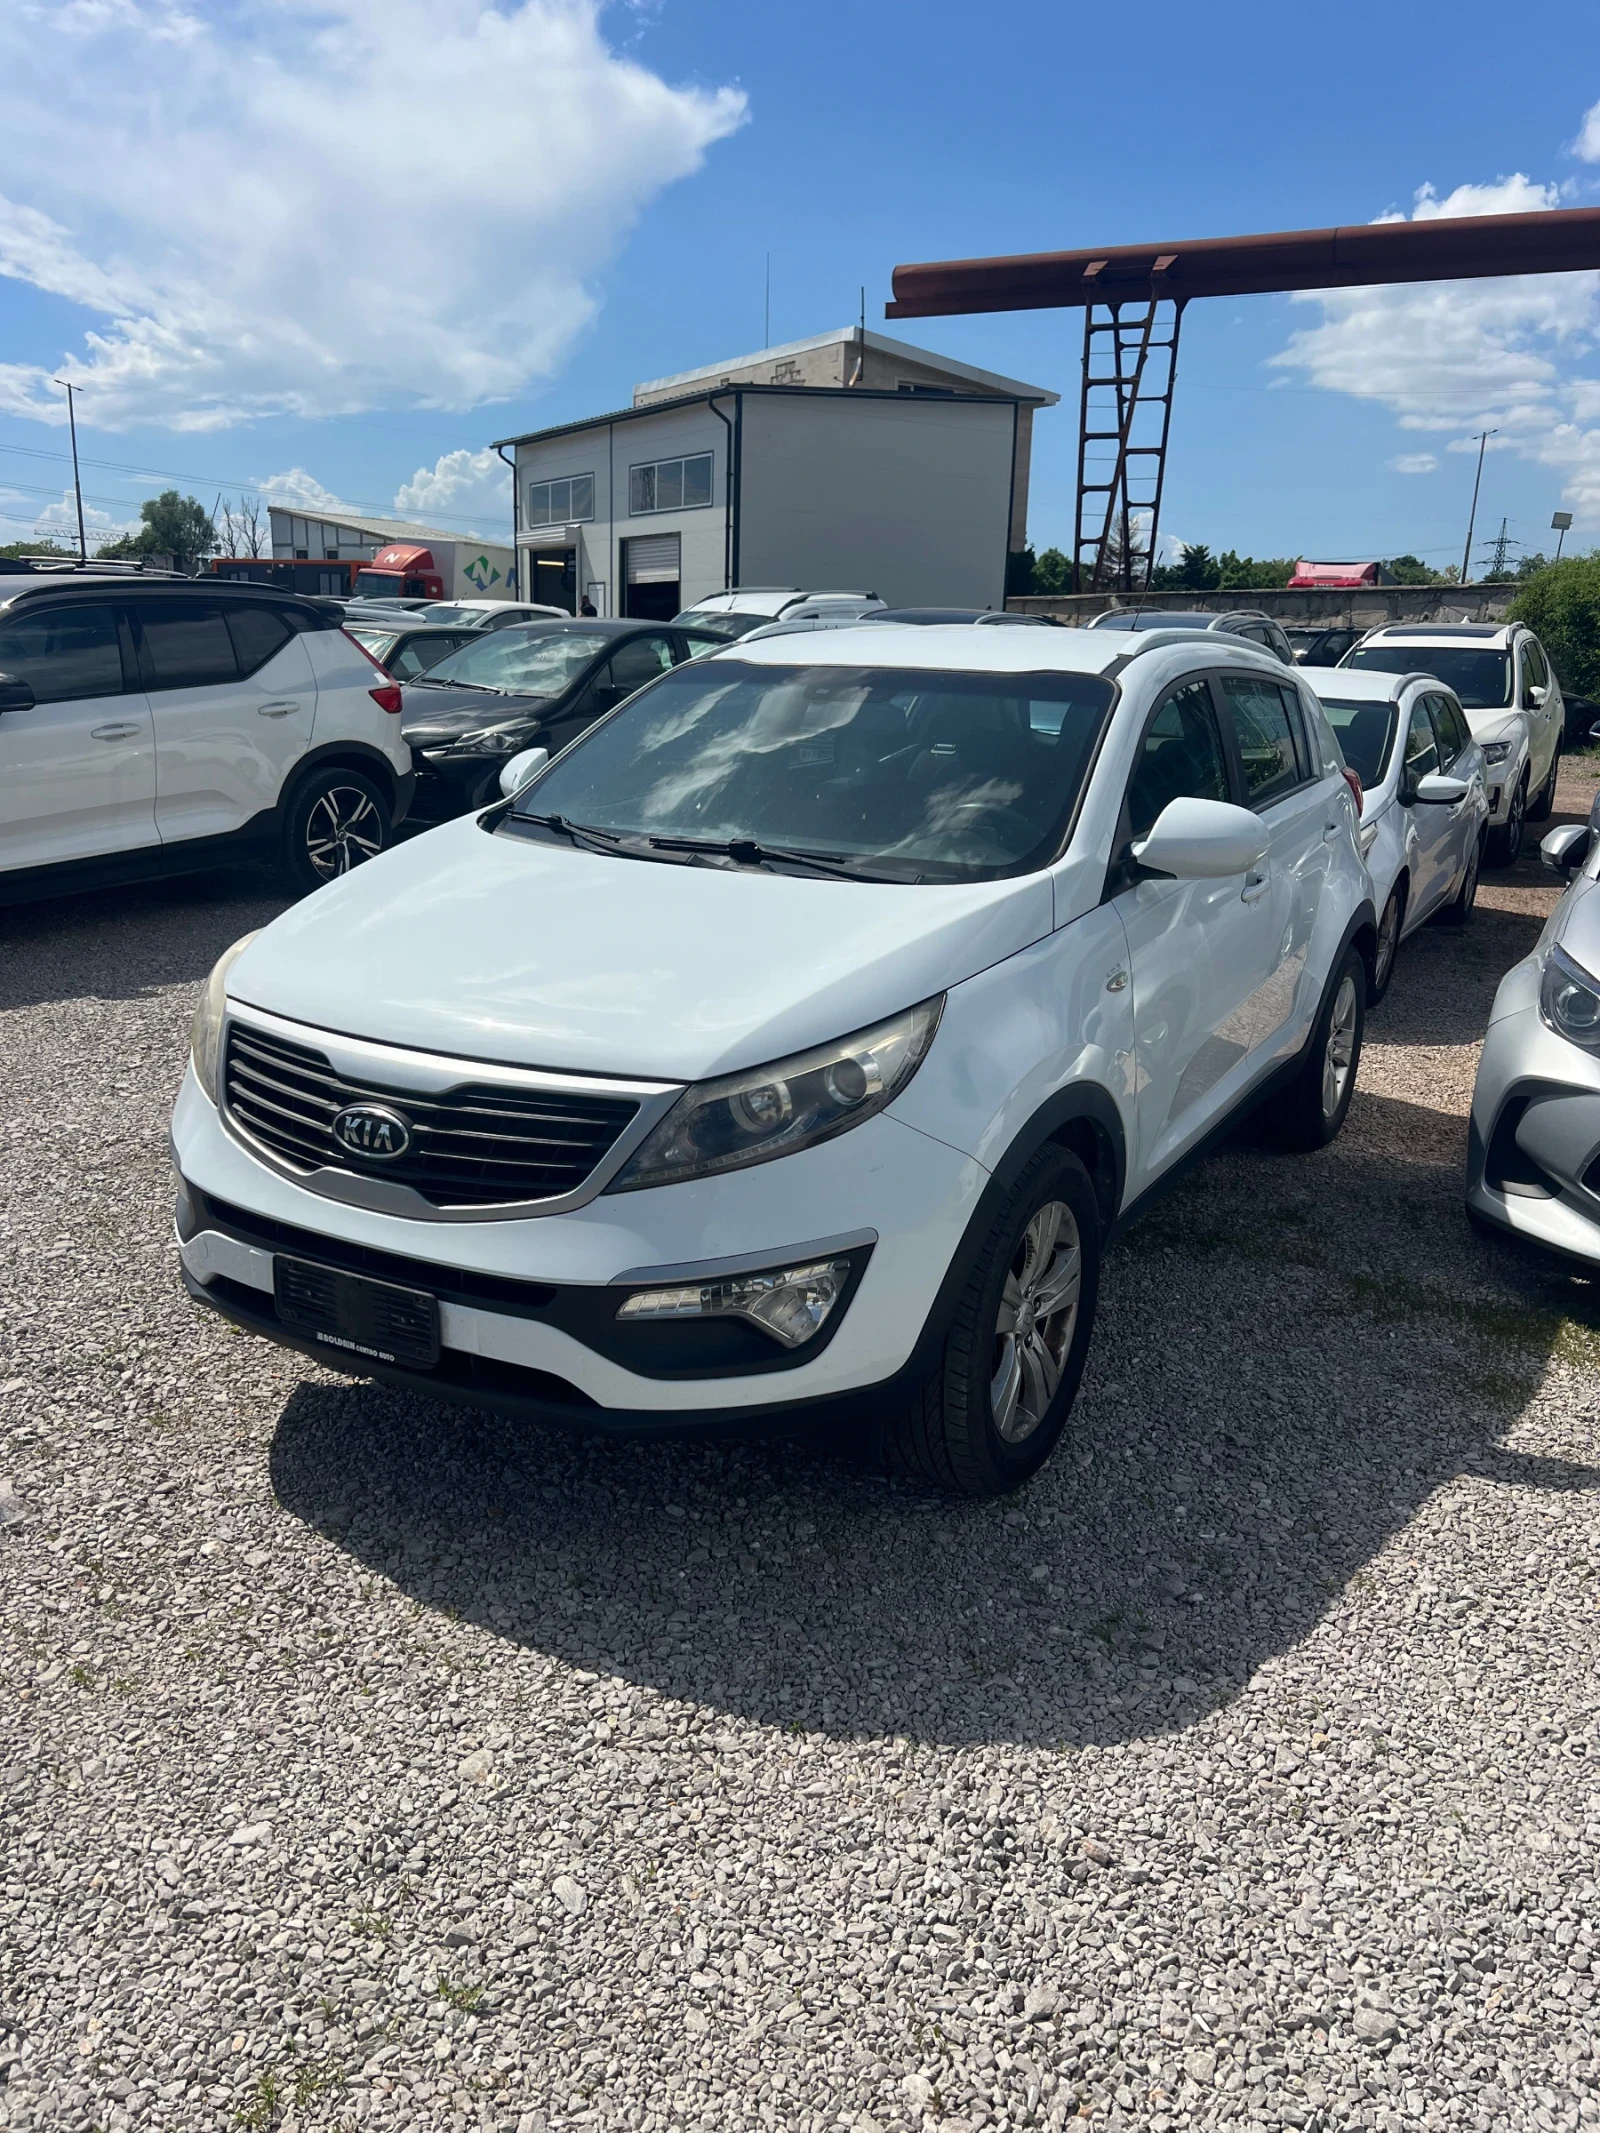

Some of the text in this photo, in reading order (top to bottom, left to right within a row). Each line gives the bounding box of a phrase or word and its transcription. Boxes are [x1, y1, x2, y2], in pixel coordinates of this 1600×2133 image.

[343, 1115, 394, 1152] KIA
[356, 1345, 378, 1357] CENTRO
[378, 1351, 395, 1361] AUTO
